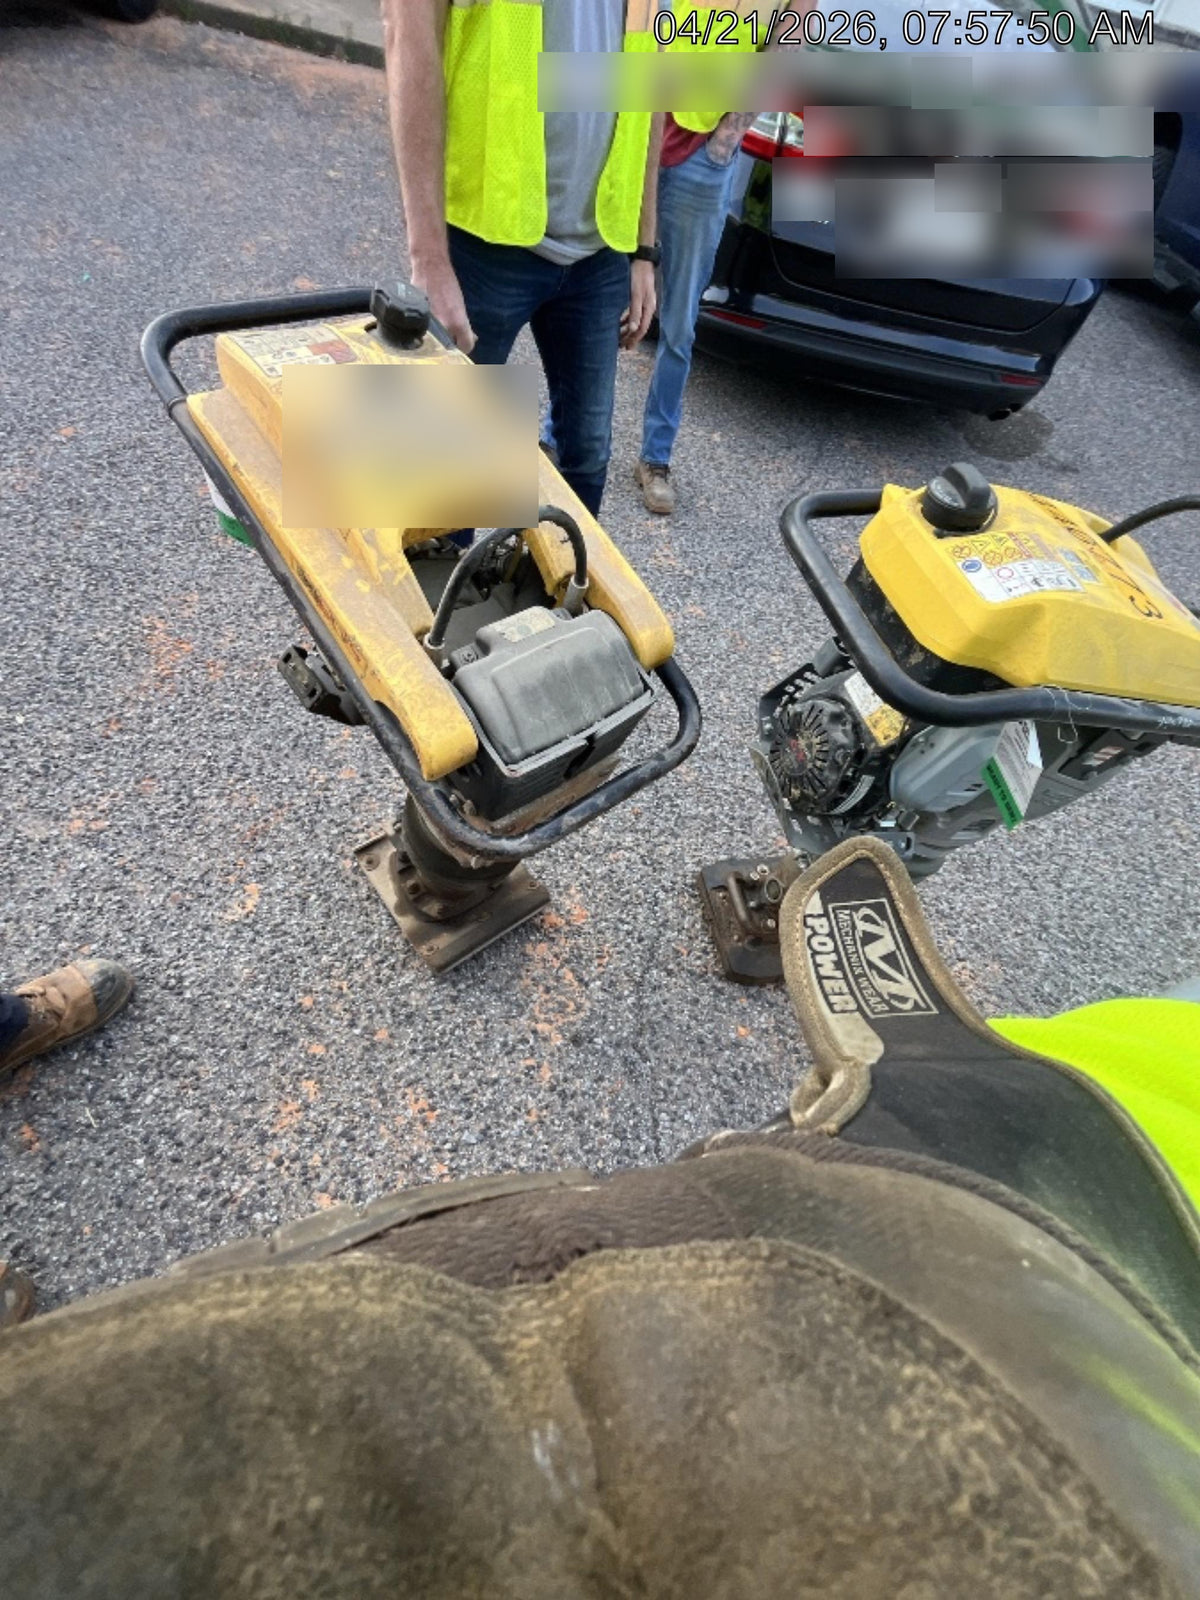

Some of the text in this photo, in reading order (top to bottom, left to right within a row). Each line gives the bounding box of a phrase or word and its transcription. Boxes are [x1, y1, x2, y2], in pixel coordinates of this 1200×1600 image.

[803, 913, 859, 1014] POWER
[835, 908, 890, 1013] MECHANIX WEAR
